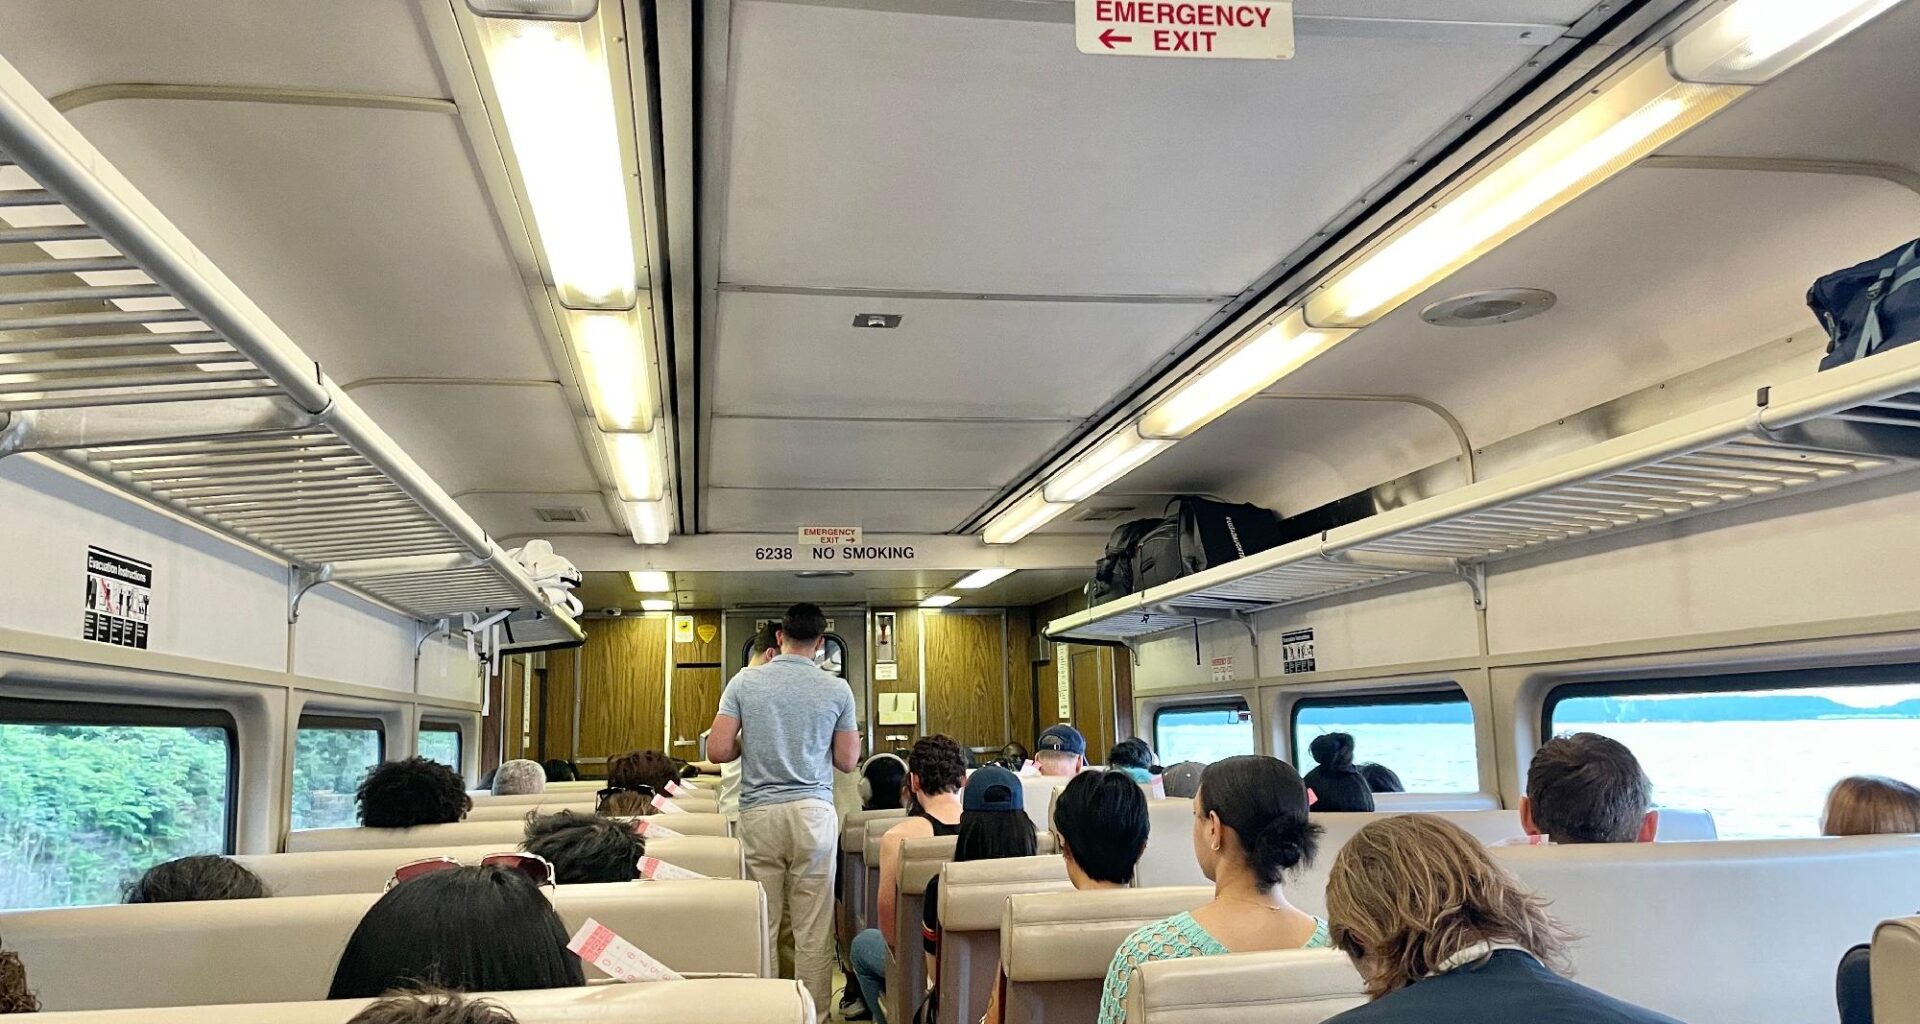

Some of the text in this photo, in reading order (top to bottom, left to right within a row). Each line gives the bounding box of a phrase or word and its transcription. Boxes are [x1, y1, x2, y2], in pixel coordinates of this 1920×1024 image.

[1096, 0, 1271, 27] EMERGENCY
[1154, 30, 1217, 52] EXIT
[804, 528, 856, 536] EMERGENCY
[820, 536, 839, 544] EXIT
[755, 546, 914, 560] 6238 NO SMOKING
[88, 556, 146, 582] Evacuation Instructions
